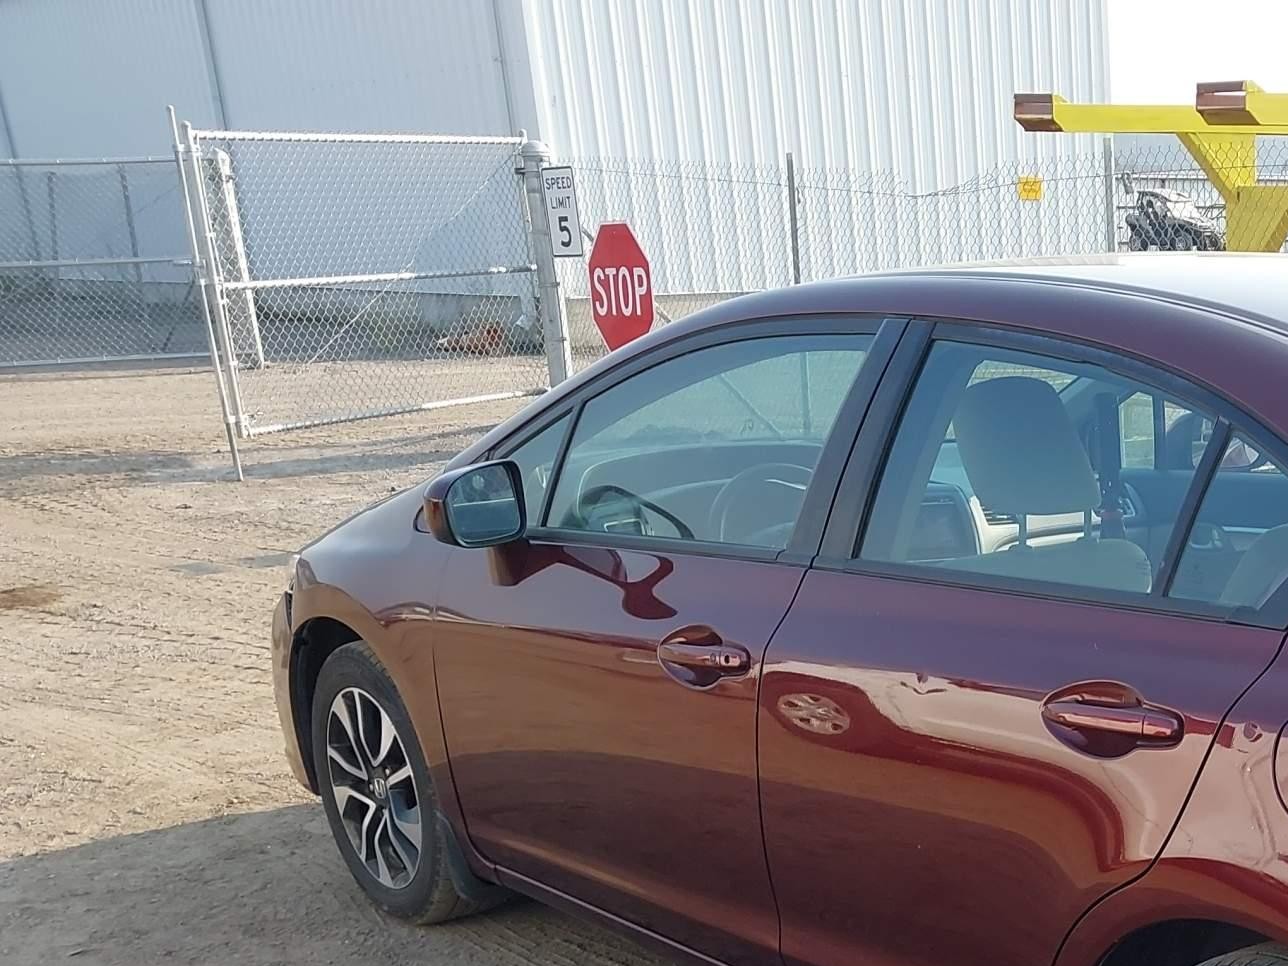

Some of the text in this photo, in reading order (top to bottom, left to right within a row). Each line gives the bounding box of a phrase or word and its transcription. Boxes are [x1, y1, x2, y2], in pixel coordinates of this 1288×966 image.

[545, 176, 572, 190] SPEED
[551, 196, 571, 209] LIMIT
[558, 216, 572, 247] 5
[593, 266, 648, 317] STOP
